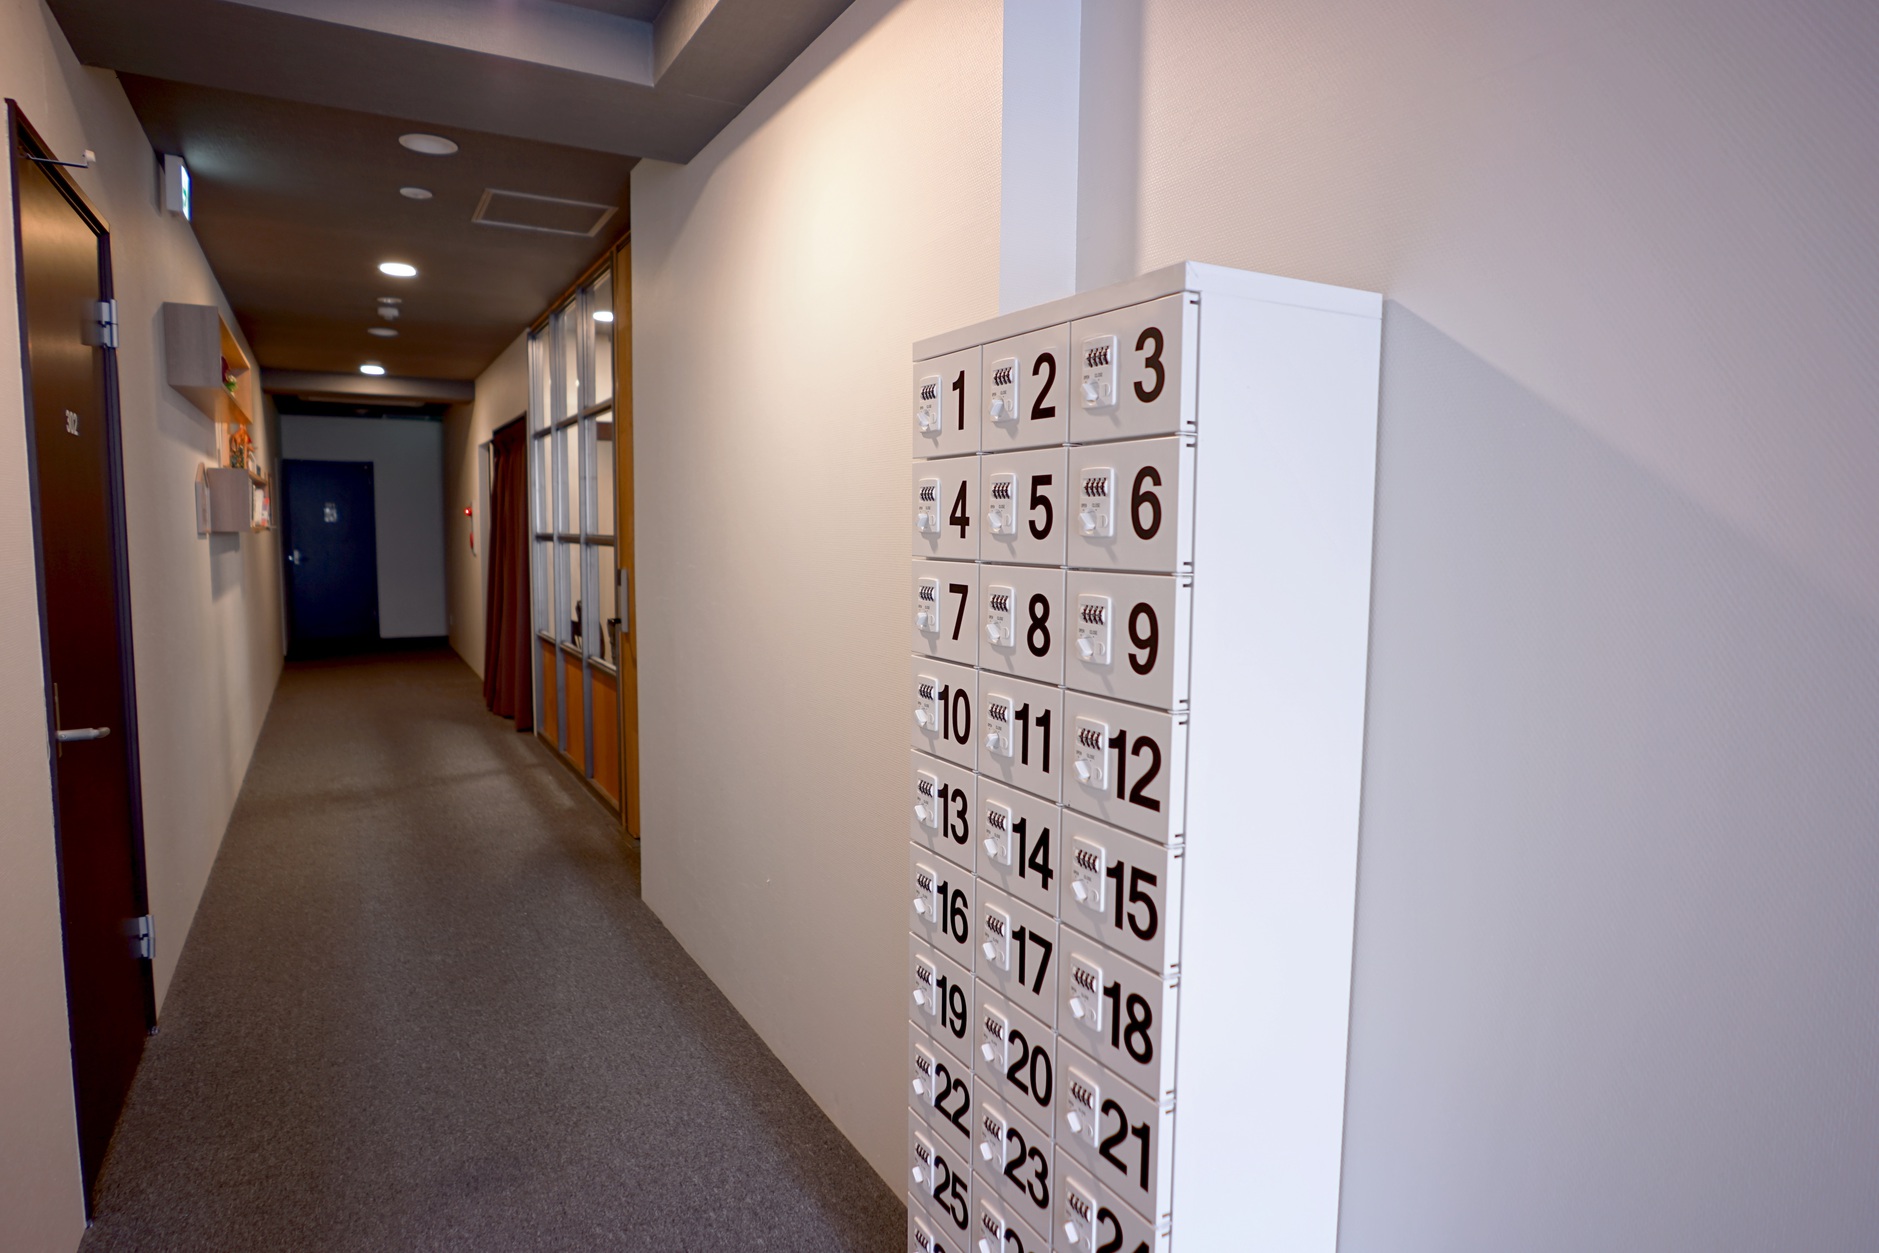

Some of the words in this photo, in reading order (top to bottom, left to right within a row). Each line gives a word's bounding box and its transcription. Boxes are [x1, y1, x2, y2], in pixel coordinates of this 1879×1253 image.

[1030, 352, 1057, 421] 2
[1133, 326, 1165, 403] 3
[65, 409, 79, 436] 302
[951, 370, 966, 431] 1
[949, 480, 970, 539] 4
[1028, 474, 1054, 541] 5
[1130, 465, 1162, 541] 6
[948, 583, 969, 641] 7
[1026, 593, 1051, 658] 8
[1128, 602, 1159, 676] 9
[937, 684, 971, 745] 10
[1014, 702, 1051, 774] 11
[1108, 729, 1162, 813] 12
[937, 783, 969, 845] 13
[1012, 816, 1054, 891] 14
[936, 880, 969, 944] 16
[1106, 860, 1158, 941] 15
[1011, 925, 1053, 996] 17
[936, 974, 968, 1039] 19
[1103, 980, 1154, 1065] 18
[934, 1062, 971, 1140] 22
[1006, 1029, 1053, 1108] 20
[1003, 1127, 1050, 1210] 23
[1098, 1098, 1151, 1193] 21
[932, 1155, 969, 1231] 25
[1095, 1207, 1150, 1253] 2
